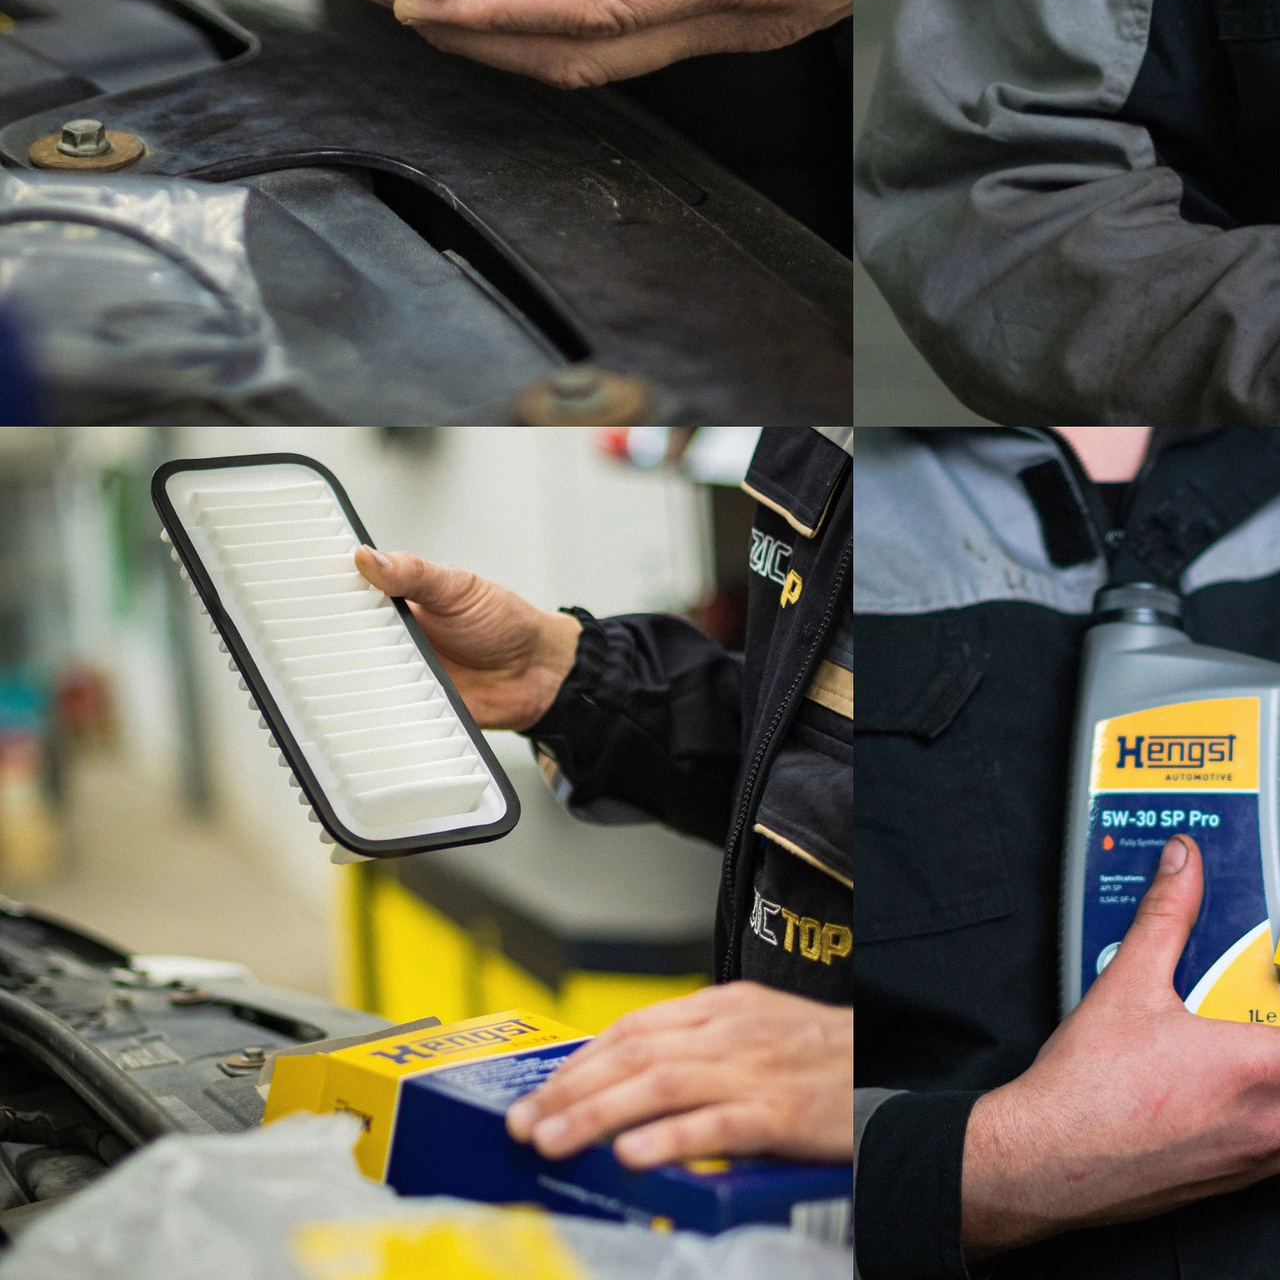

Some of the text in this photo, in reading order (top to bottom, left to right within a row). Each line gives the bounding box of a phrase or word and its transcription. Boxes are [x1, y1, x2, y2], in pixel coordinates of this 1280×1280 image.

[1116, 734, 1236, 768] Hengst
[1165, 773, 1233, 781] AUTOMOTIVE
[1102, 810, 1220, 827] 5W-30 SP Pro
[1120, 838, 1136, 846] Fully
[1100, 874, 1145, 882] Specifications:
[369, 1018, 541, 1065] Hengst
